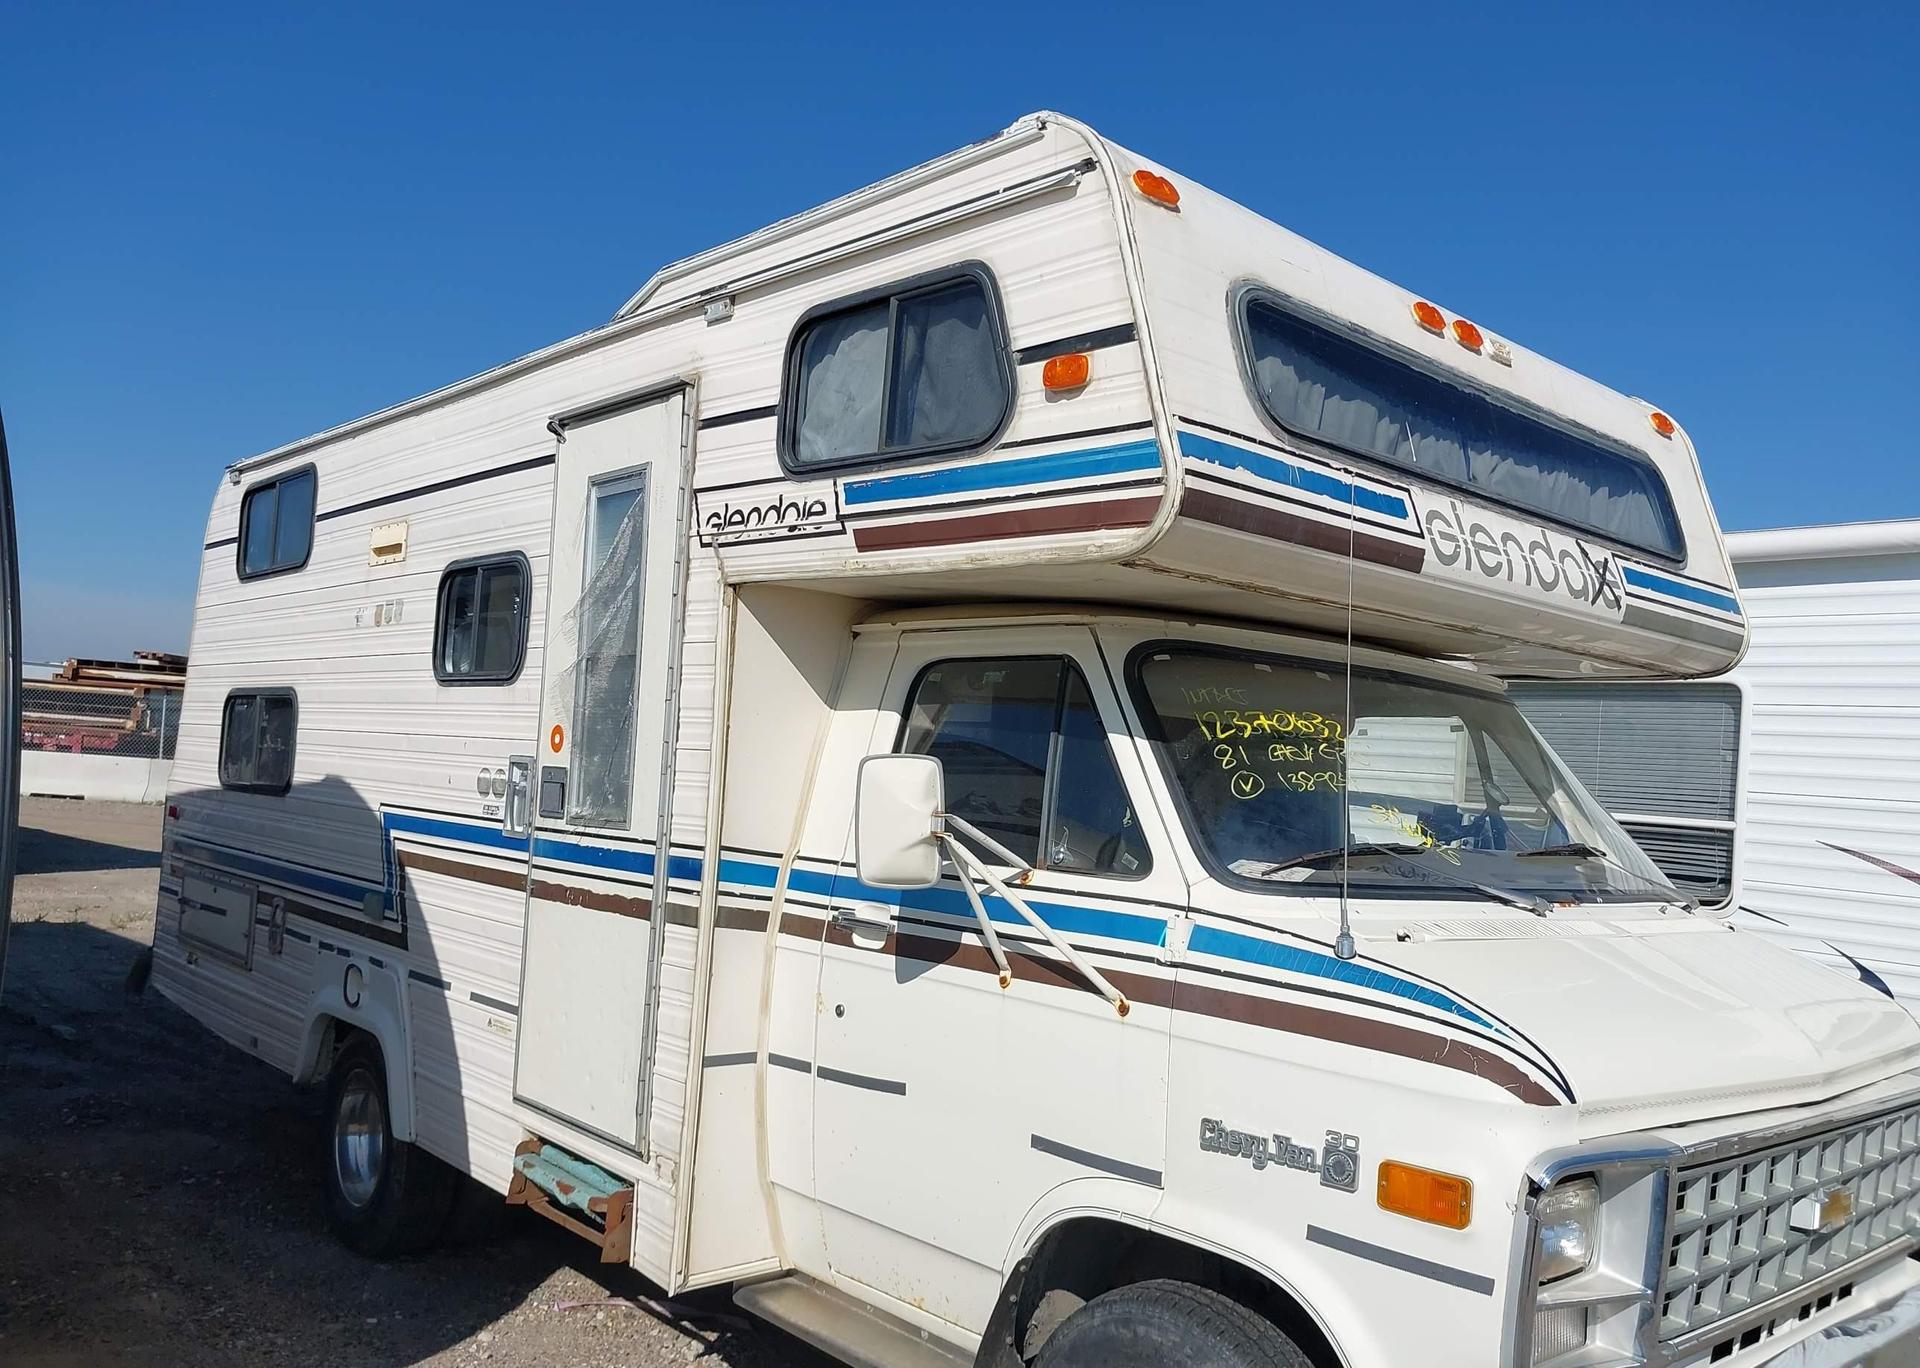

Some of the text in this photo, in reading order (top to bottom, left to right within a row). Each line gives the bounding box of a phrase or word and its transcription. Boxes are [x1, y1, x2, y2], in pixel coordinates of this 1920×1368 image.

[1213, 743, 1251, 769] 81
[1199, 1117, 1360, 1173] Chevy Van 30
